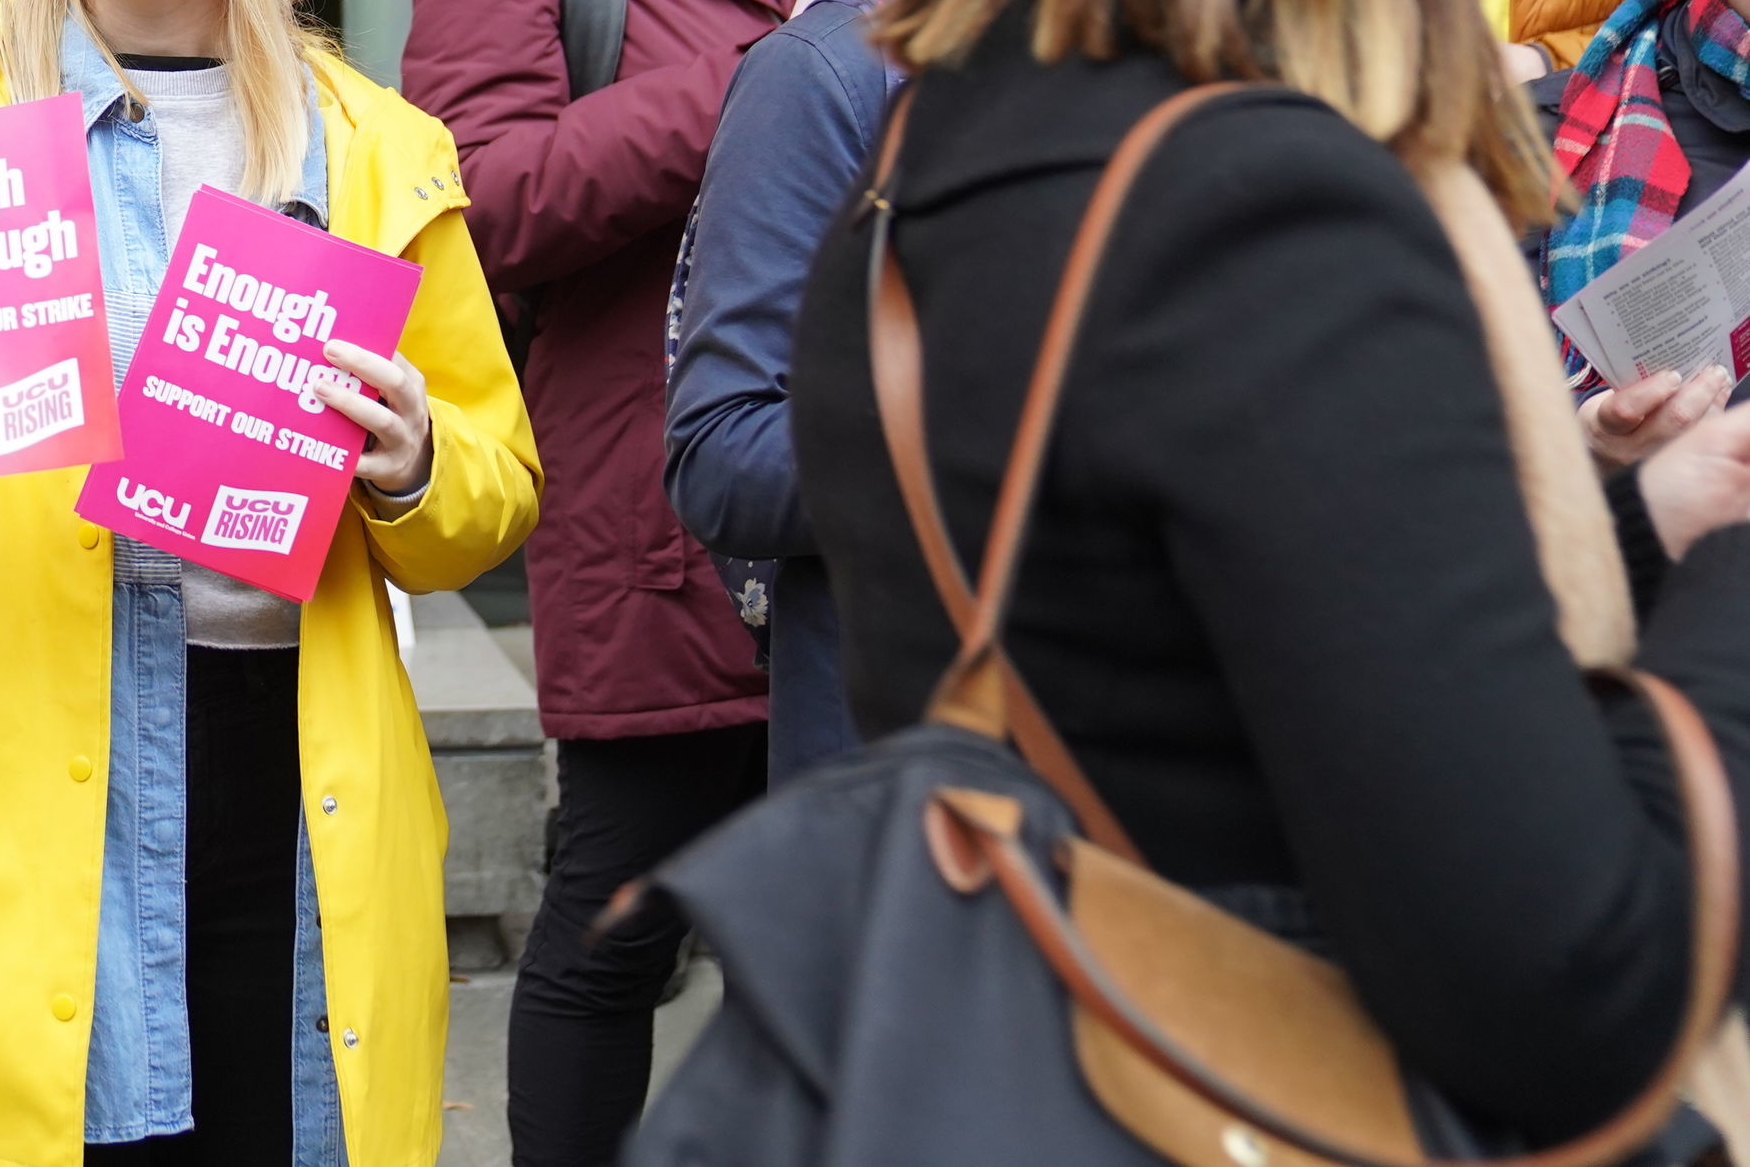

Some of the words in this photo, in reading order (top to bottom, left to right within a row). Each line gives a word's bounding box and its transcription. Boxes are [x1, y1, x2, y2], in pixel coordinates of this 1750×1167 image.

[21, 293, 94, 329] STRIKE
[182, 242, 338, 344] Enough
[162, 297, 206, 353] is
[3, 390, 73, 442] RISING
[142, 375, 232, 428] SUPPORT
[230, 411, 275, 446] OUR
[275, 428, 349, 472] STRIKE
[214, 509, 289, 546] RISING
